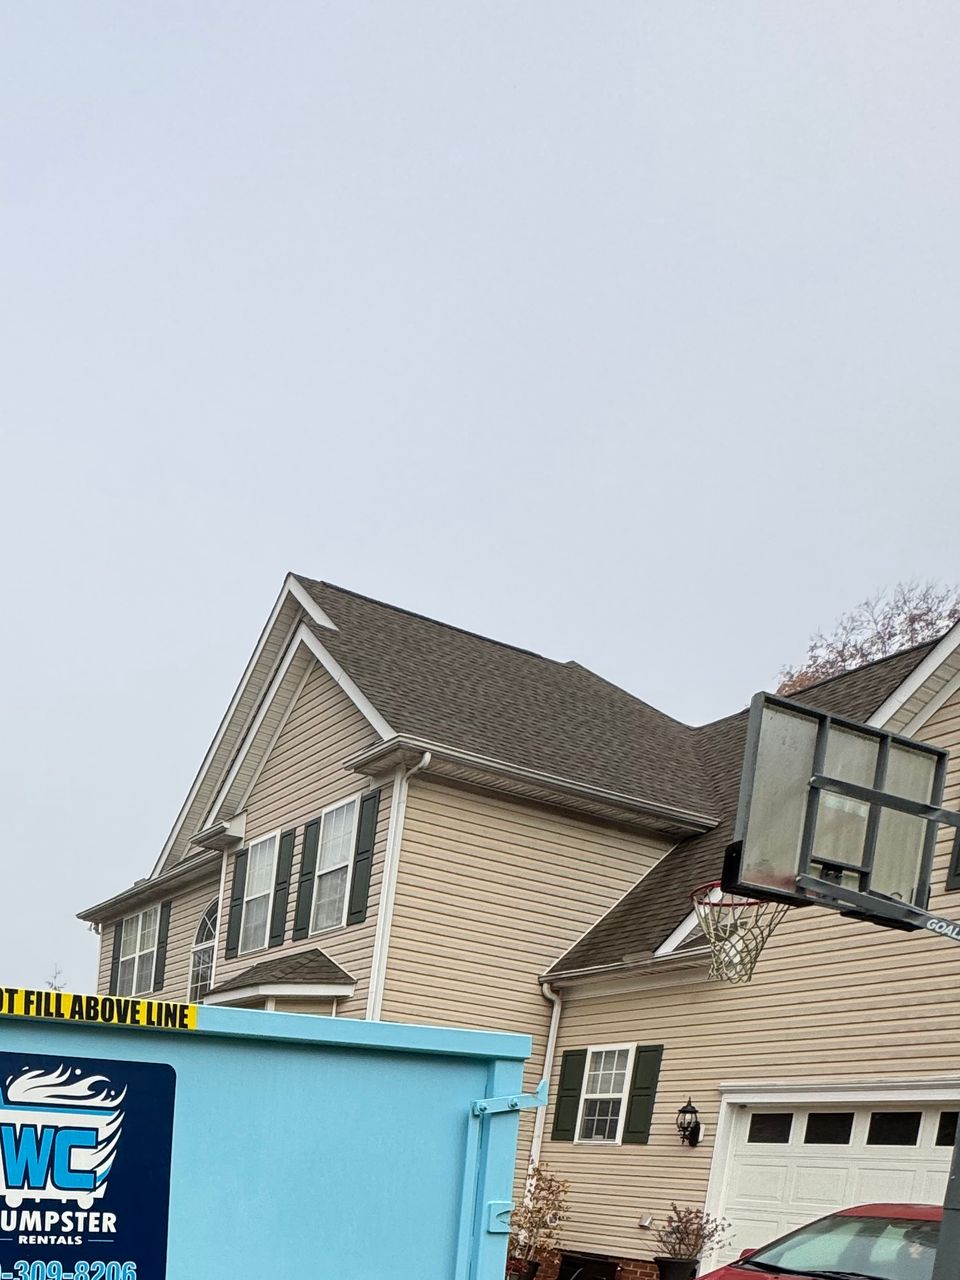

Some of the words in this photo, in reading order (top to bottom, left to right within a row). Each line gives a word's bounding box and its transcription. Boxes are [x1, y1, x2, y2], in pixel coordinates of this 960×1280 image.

[23, 990, 65, 1019] FILL
[69, 994, 141, 1024] ABOVE
[146, 1000, 189, 1029] LINE
[0, 1123, 98, 1191] WC
[18, 1235, 83, 1245] RENTALS
